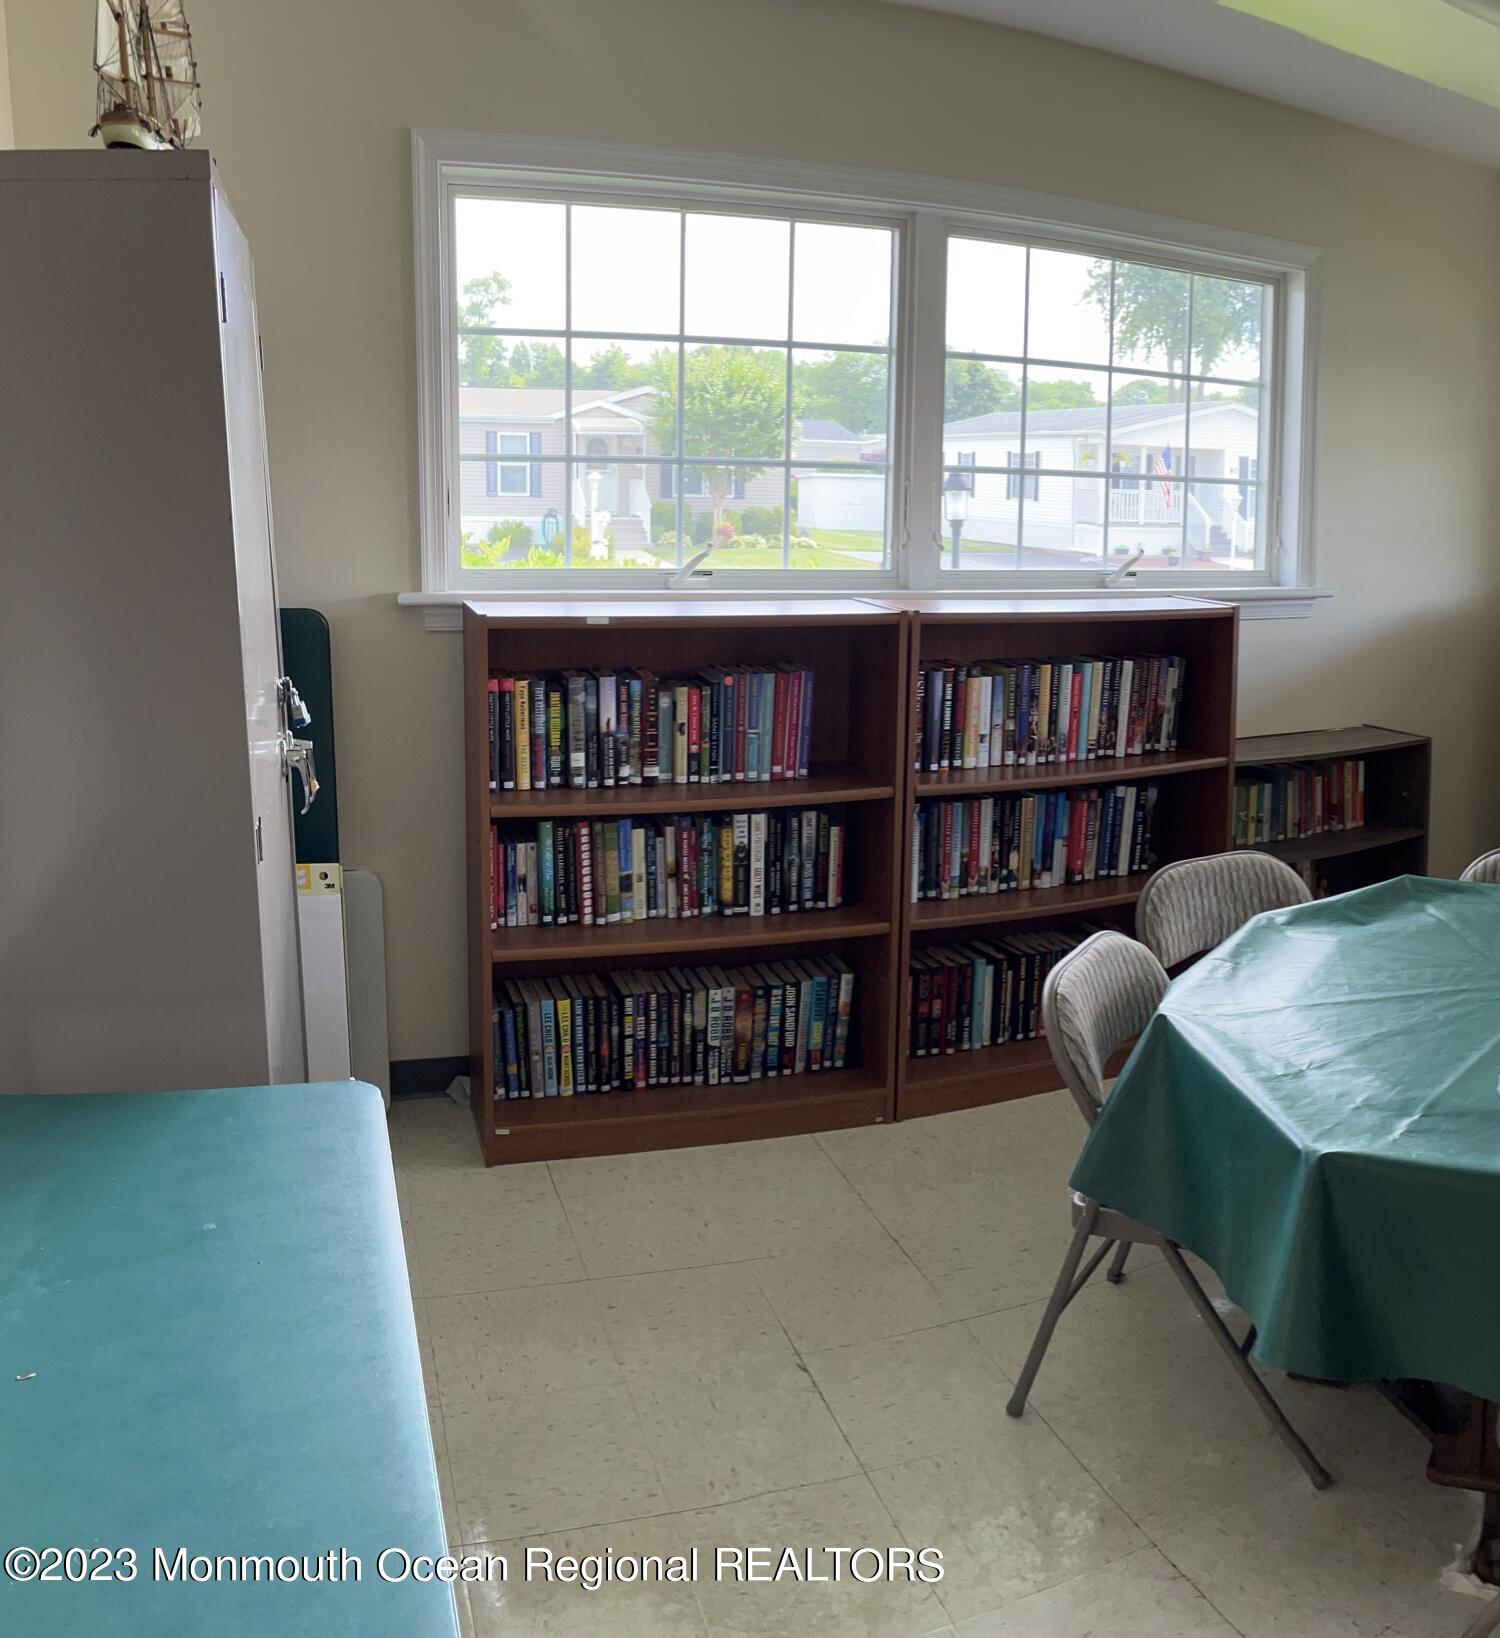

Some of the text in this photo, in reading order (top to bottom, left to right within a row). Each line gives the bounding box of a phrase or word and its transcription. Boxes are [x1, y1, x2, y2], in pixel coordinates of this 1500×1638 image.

[944, 683, 953, 730] KARIN SLAUGHTER
[633, 717, 641, 742] KRENTZ
[785, 985, 796, 1047] JOHN SANDFORD
[813, 989, 825, 1022] SANDFORD
[544, 1012, 553, 1043] LEE CHILD
[562, 1012, 570, 1042] LEE CHILD
[636, 1016, 645, 1039] REICHS
[711, 1016, 719, 1041] ROBB
[722, 1016, 732, 1041] ROBB
